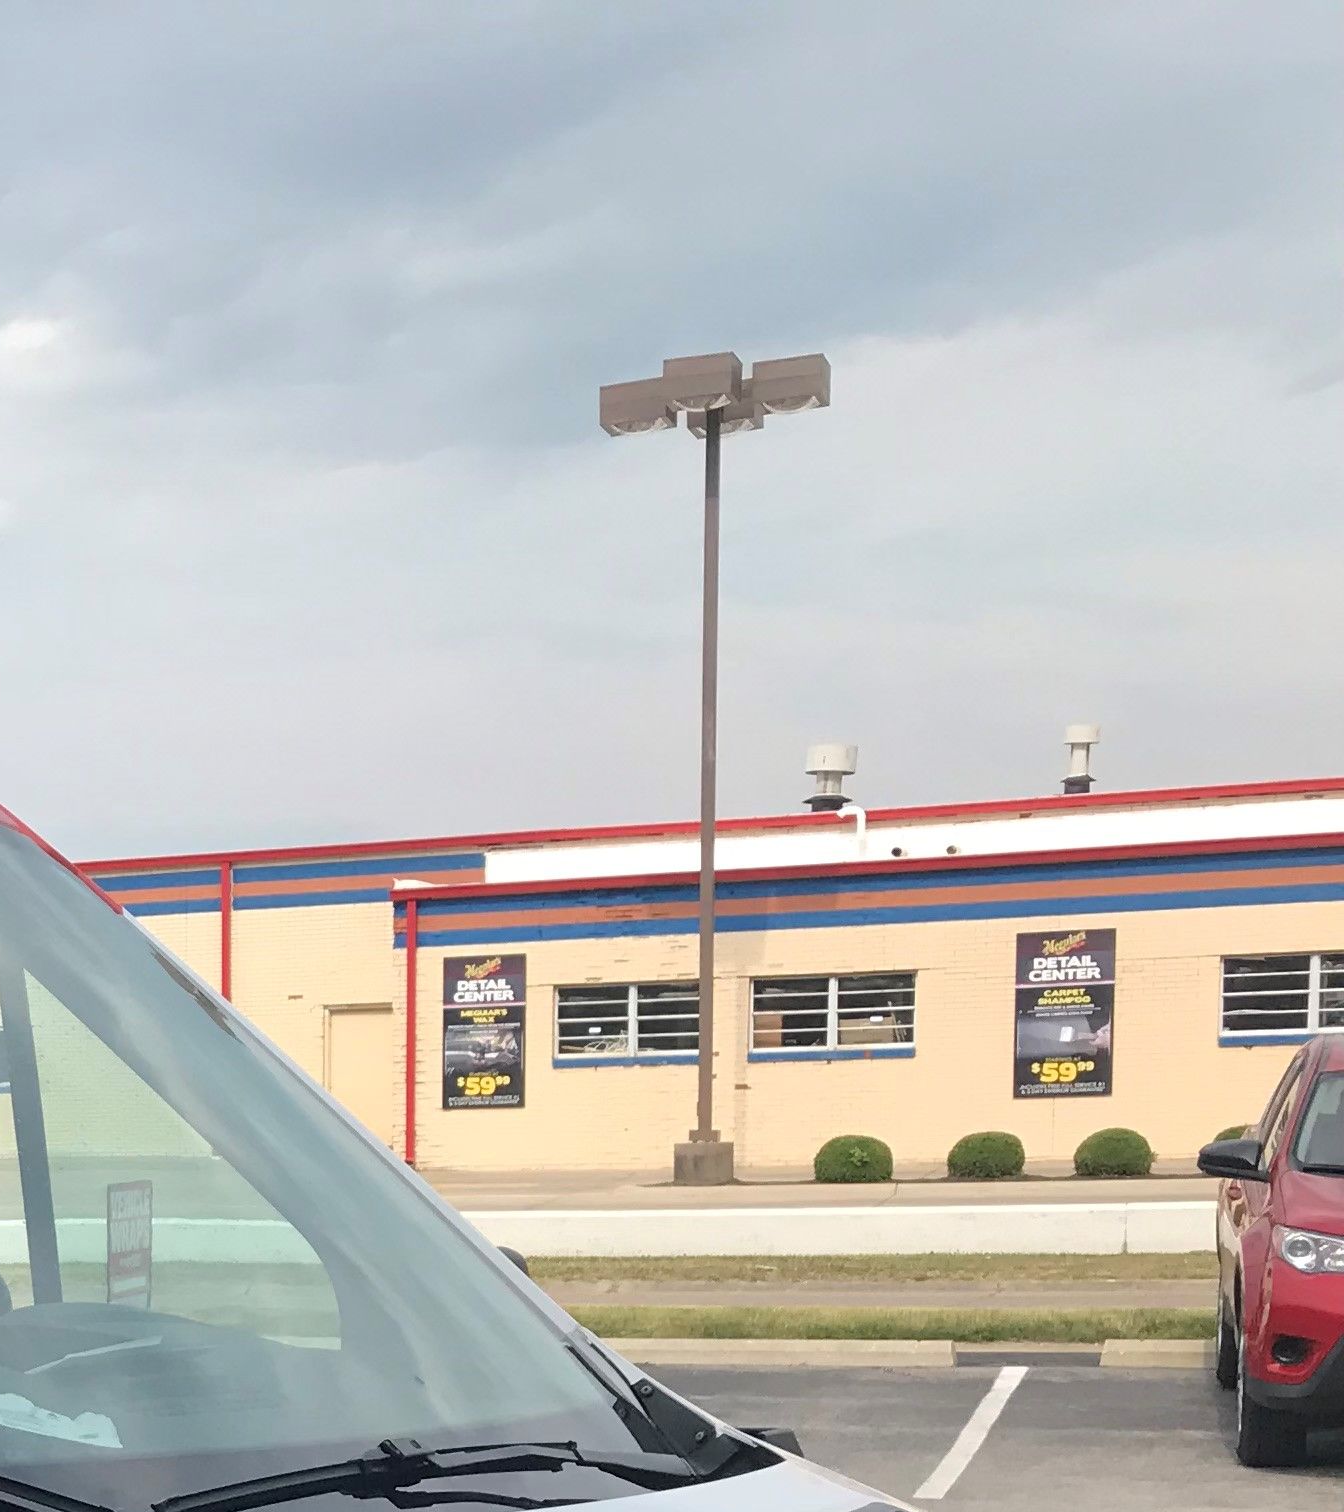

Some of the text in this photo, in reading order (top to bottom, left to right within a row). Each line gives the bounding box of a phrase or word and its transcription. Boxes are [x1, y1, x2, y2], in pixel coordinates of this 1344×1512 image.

[1032, 955, 1098, 970] DETAIL
[1028, 967, 1102, 982] CENTER
[457, 978, 512, 991] DETAIL
[453, 990, 515, 1003] CENTER
[1043, 988, 1086, 998] CARPET
[1037, 995, 1092, 1006] SHAMPOO
[473, 1016, 496, 1024] WAX
